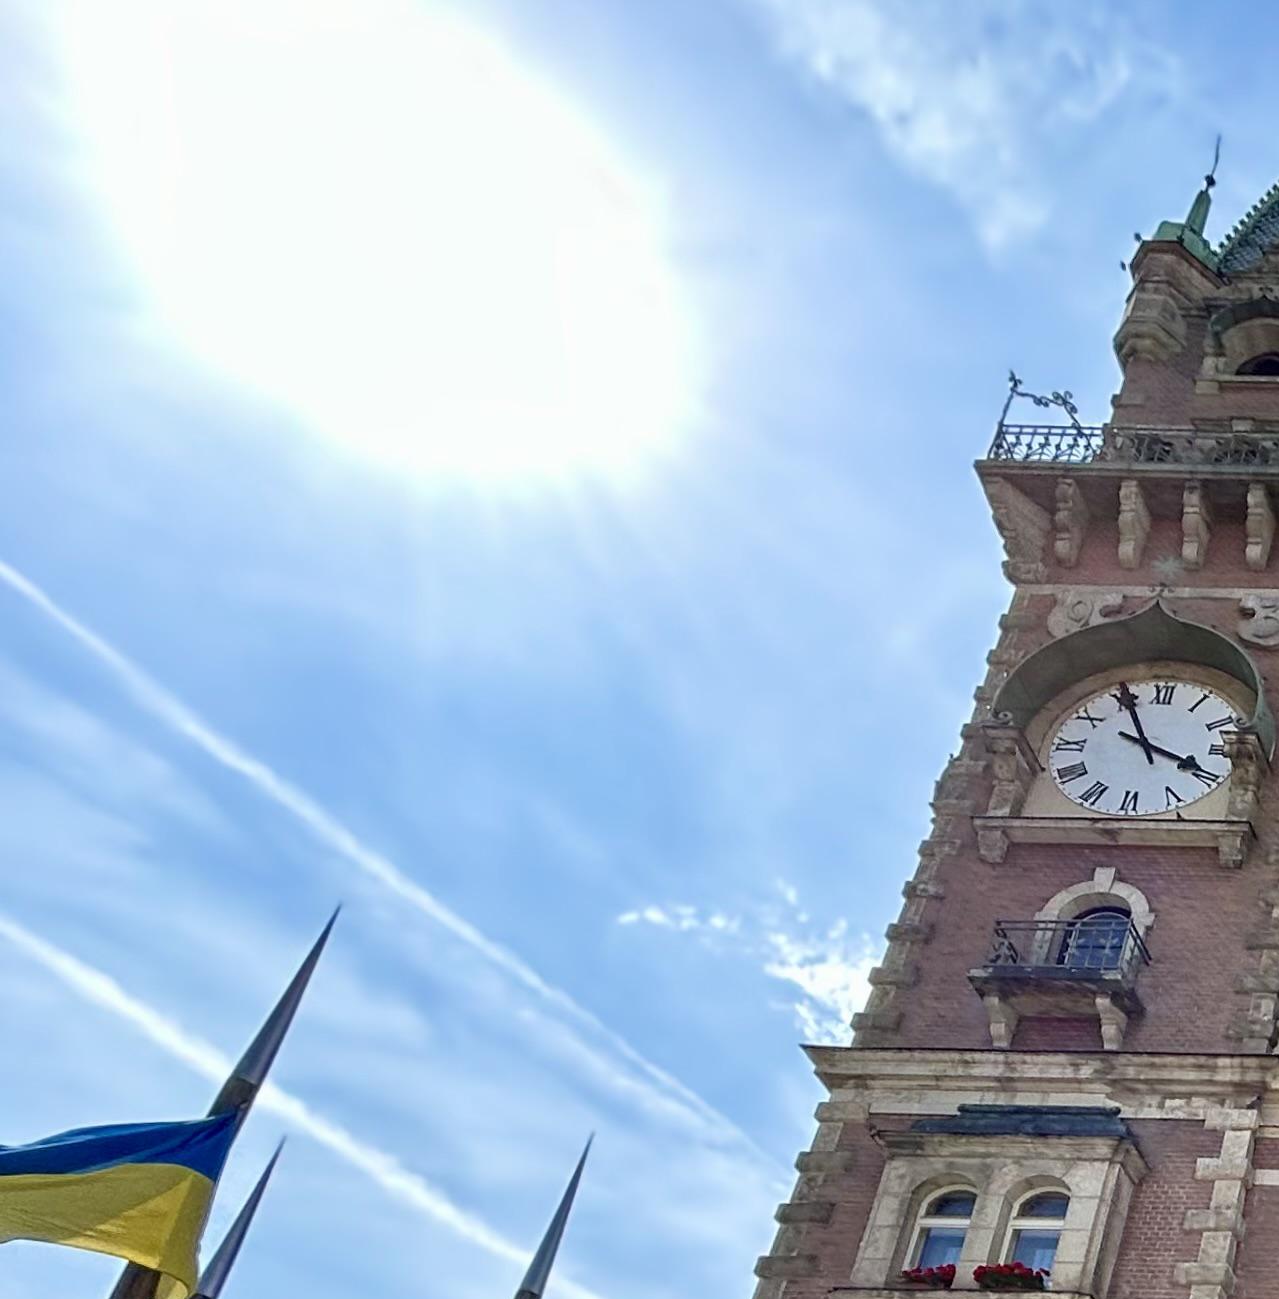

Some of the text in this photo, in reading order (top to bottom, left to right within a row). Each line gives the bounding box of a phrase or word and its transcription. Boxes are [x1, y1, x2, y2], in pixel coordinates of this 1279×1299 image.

[1150, 684, 1176, 705] XII
[1188, 694, 1209, 712] I
[1075, 706, 1106, 729] X
[1205, 715, 1234, 731] II
[1054, 737, 1087, 752] IX
[1118, 791, 1138, 813] VI
[1165, 786, 1185, 808] V
